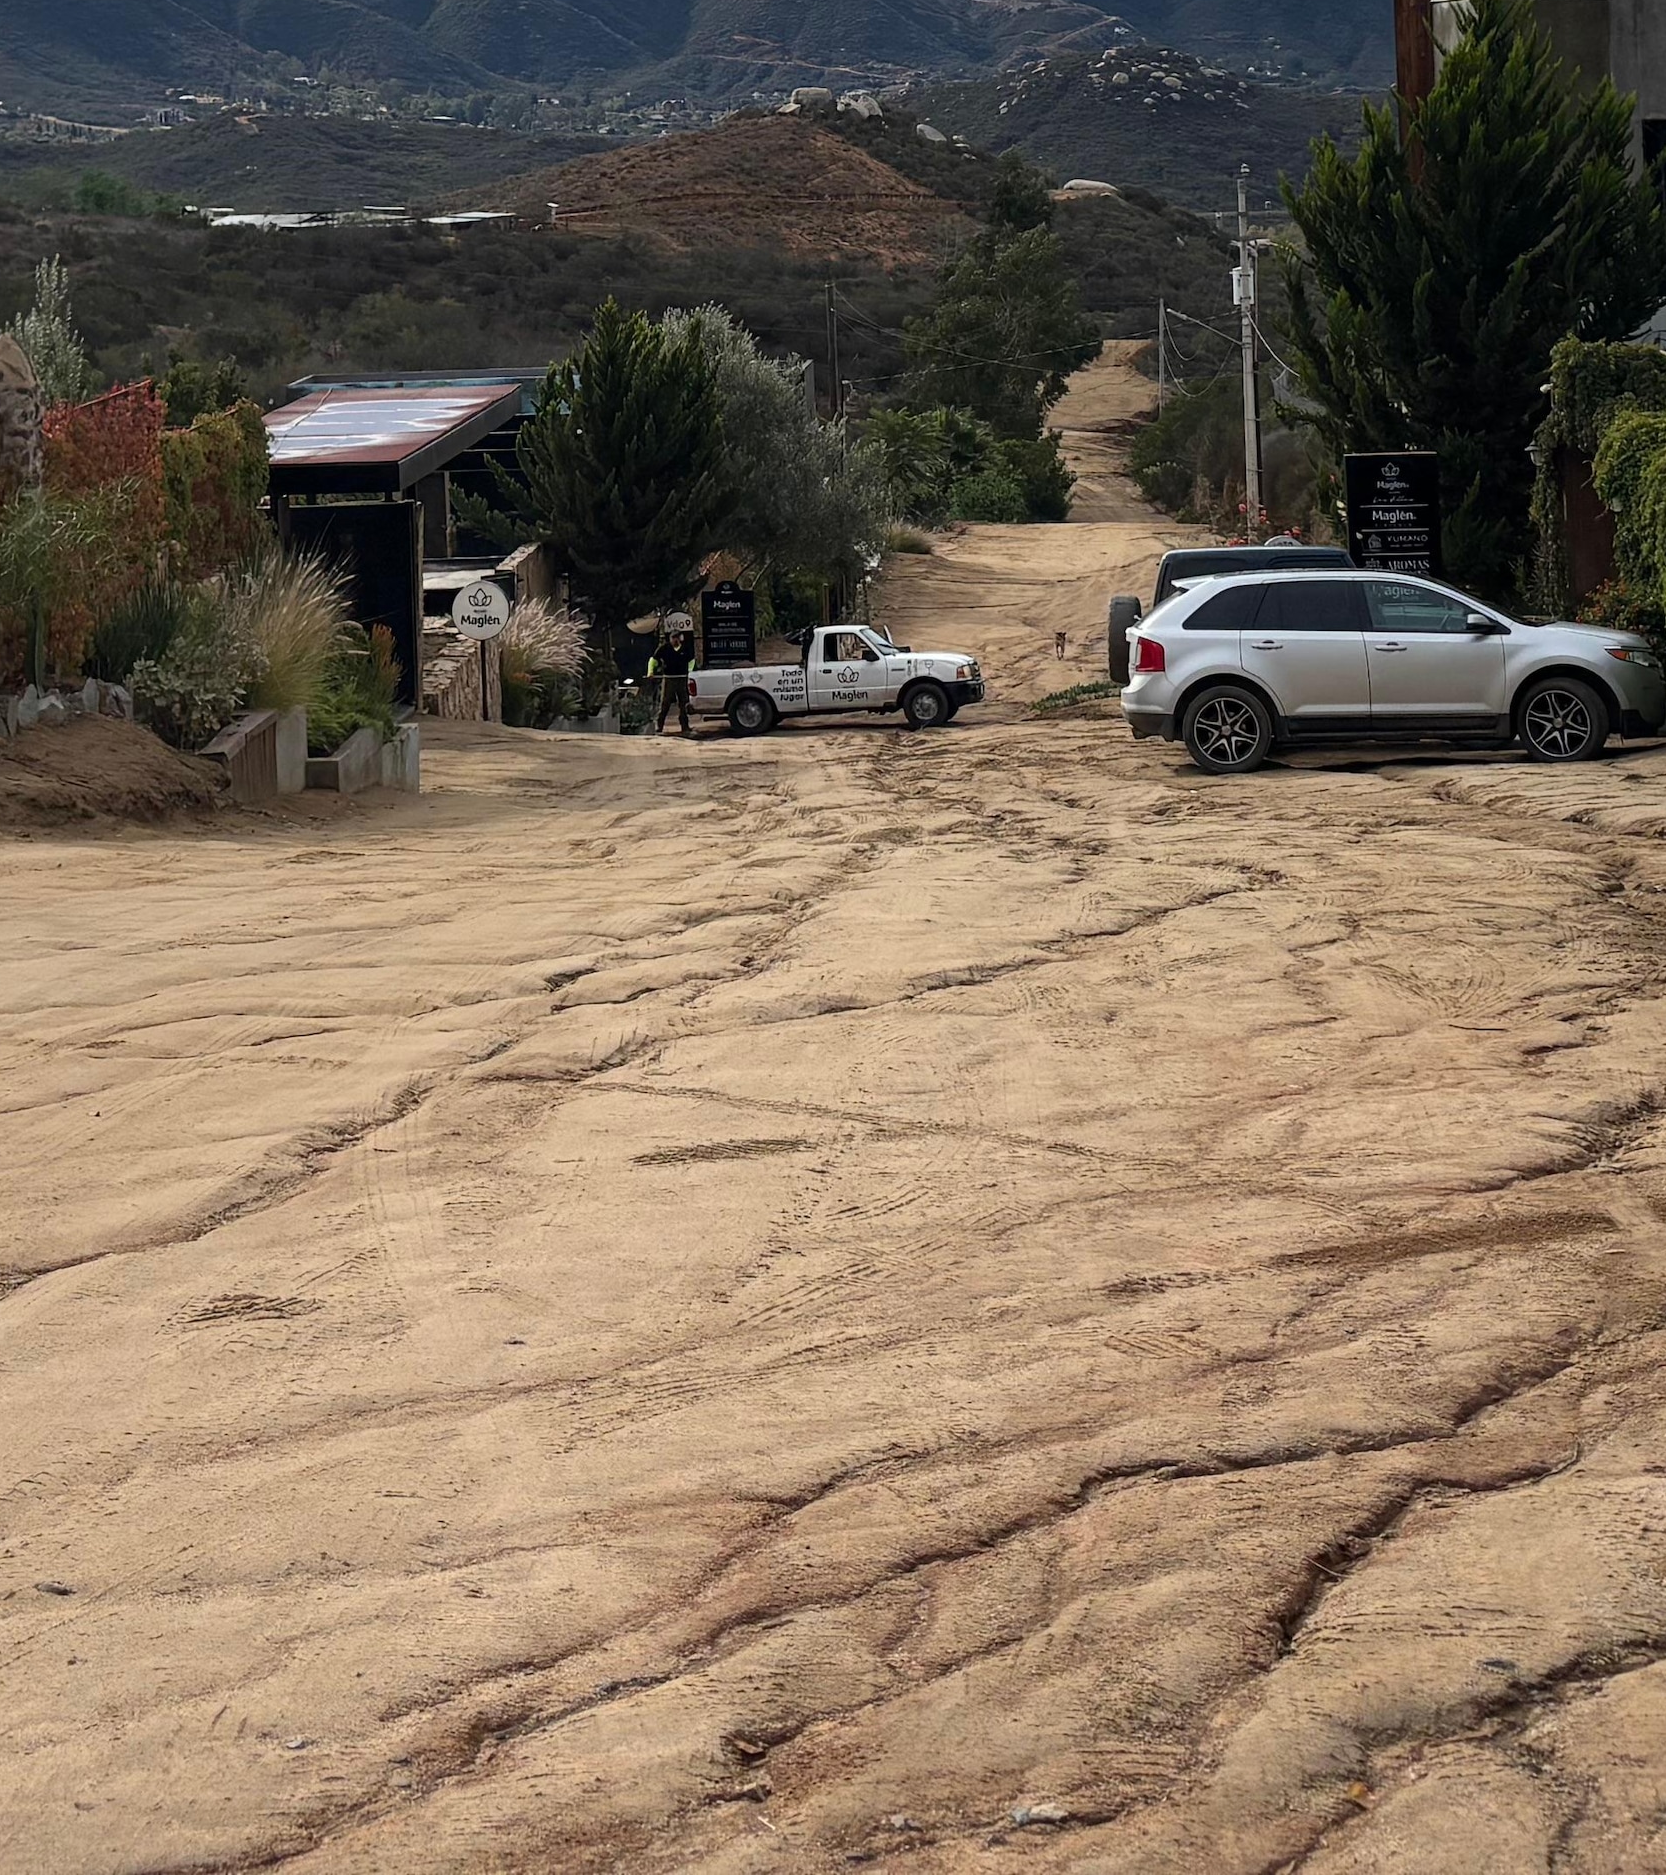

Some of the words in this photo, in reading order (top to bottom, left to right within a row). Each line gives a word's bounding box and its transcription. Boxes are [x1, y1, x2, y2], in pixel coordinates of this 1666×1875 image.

[1388, 559, 1430, 572] AROMAS
[781, 669, 803, 677] Todo
[777, 678, 790, 686] en
[791, 677, 804, 685] un
[772, 685, 804, 693] mismo
[779, 693, 804, 702] lugar
